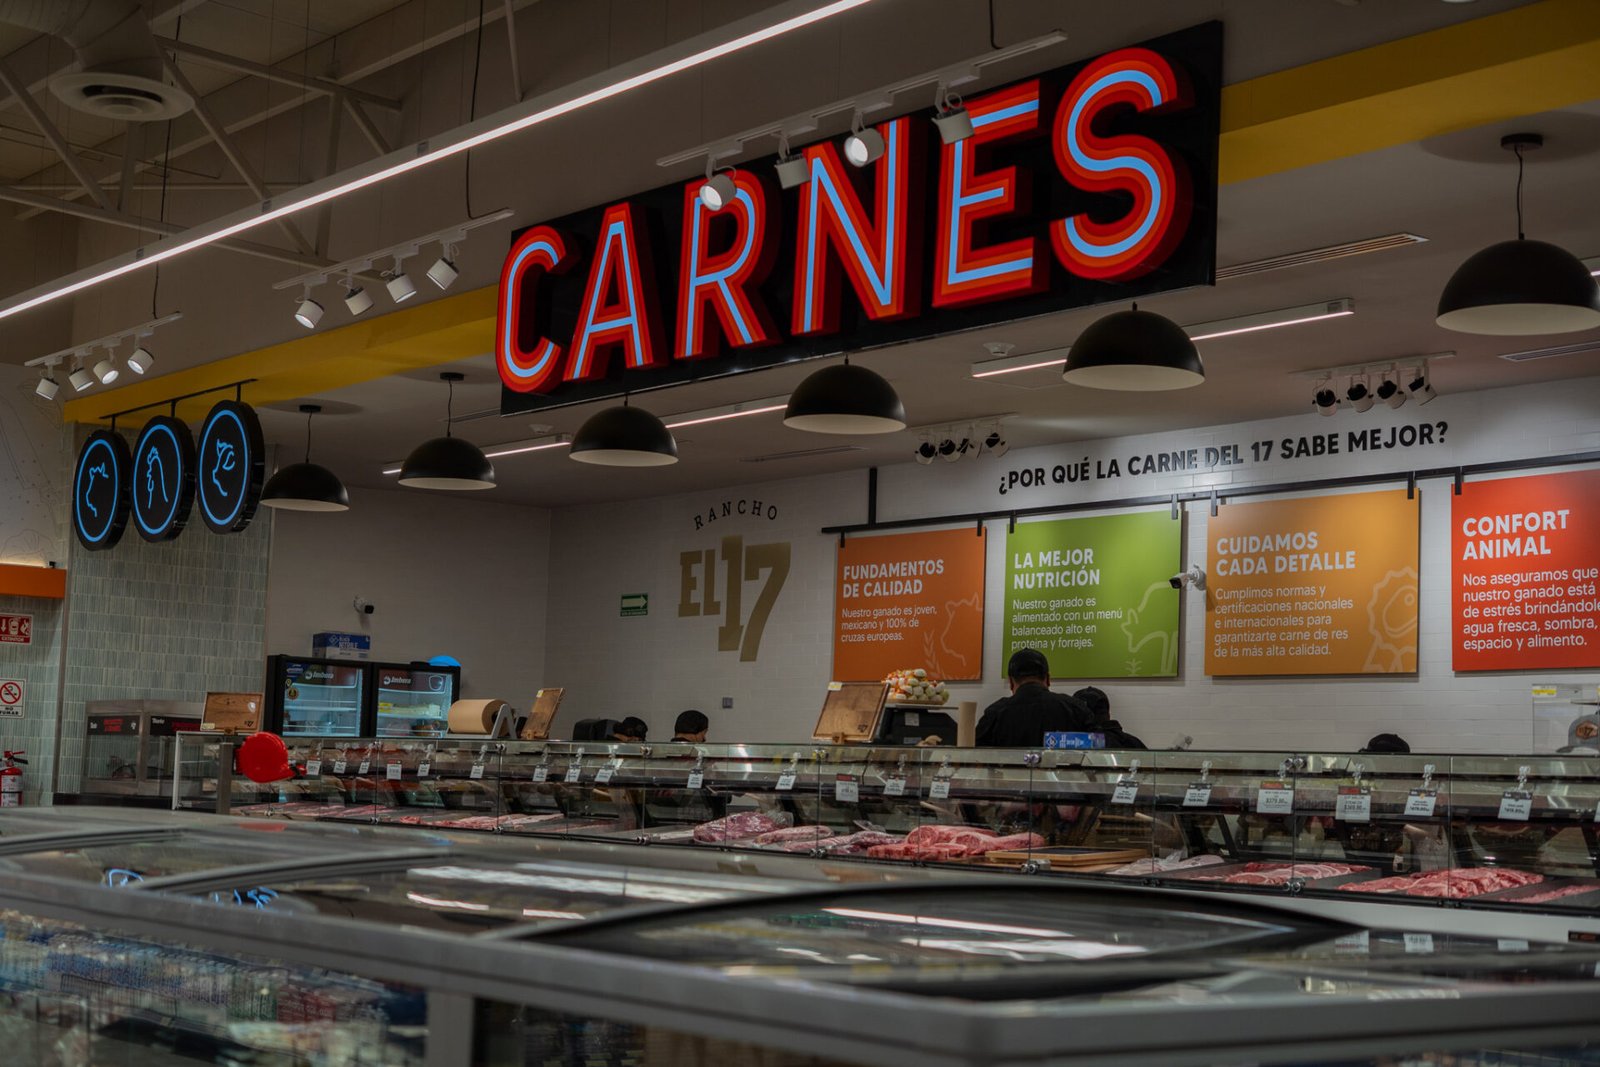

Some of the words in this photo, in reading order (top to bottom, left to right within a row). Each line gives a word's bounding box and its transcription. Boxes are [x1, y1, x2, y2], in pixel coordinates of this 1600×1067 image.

[495, 47, 1182, 393] CARNES
[999, 468, 1045, 495] ¿POR
[1052, 456, 1090, 483] QUÉ
[1096, 458, 1120, 479] LA
[1128, 449, 1197, 475] CARNE
[1205, 444, 1244, 465] DEL
[1251, 440, 1273, 461] 17
[1281, 433, 1339, 459] SABE
[1348, 421, 1448, 452] MEJOR?
[694, 500, 777, 530] RANCHO
[1463, 509, 1569, 537] CONFORT
[1217, 532, 1318, 556] CUIDAMOS
[1463, 536, 1551, 560] ANIMAL
[1015, 553, 1033, 569] LA
[1039, 549, 1093, 567] MEJOR
[1216, 557, 1267, 576] CADA
[1276, 551, 1355, 572] DETALLE
[844, 558, 944, 580] FUNDAMENTOS
[1014, 566, 1100, 589] NUTRICIÓN
[1464, 574, 1486, 586] Nos
[1490, 570, 1568, 587] aseguramos
[1572, 568, 1599, 583] que
[843, 583, 859, 598] DE
[864, 579, 922, 596] CALIDAD
[1216, 587, 1273, 601] Cumplimos
[1277, 586, 1316, 596] normas
[1319, 586, 1326, 597] y
[1464, 590, 1510, 602] nuestro
[1514, 584, 1563, 602] ganado
[1568, 582, 1595, 596] está
[678, 549, 720, 617] EL
[718, 535, 791, 662] 17
[1013, 599, 1047, 609] Nuestro
[1049, 597, 1083, 610] ganado
[1086, 598, 1096, 606] es
[1215, 599, 1291, 613] certificaciones
[1295, 599, 1353, 610] nacionales
[842, 608, 872, 617] Nuestro
[873, 606, 902, 619] ganado
[914, 606, 937, 617] joven,
[1012, 611, 1061, 623] alimentado
[1063, 612, 1080, 621] con
[1083, 611, 1094, 620] un
[1097, 608, 1122, 619] menú
[1463, 606, 1479, 618] de
[1483, 603, 1521, 617] estrés
[842, 621, 877, 630] mexicano
[879, 621, 884, 631] y
[887, 618, 907, 628] 100%
[909, 618, 919, 627] de
[1012, 624, 1063, 636] balanceado
[1066, 624, 1083, 634] alto
[1085, 625, 1096, 633] en
[1215, 620, 1221, 628] e
[1224, 615, 1304, 628] internacionales
[1307, 616, 1332, 627] para
[1464, 623, 1494, 636] agua
[1498, 620, 1540, 632] fresca,
[1545, 616, 1597, 630] sombra,
[841, 634, 865, 642] cruzas
[867, 633, 904, 643] europeas.
[1051, 640, 1056, 650] y
[1058, 637, 1093, 649] forrajes.
[1214, 630, 1276, 644] garantizarte
[1280, 631, 1311, 640] carne
[1314, 629, 1328, 640] de
[1332, 630, 1348, 639] res
[1464, 639, 1512, 652] espacio
[1516, 638, 1523, 650] y
[1528, 634, 1587, 647] alimento.
[1214, 645, 1227, 657] de
[1230, 646, 1239, 656] la
[1242, 646, 1263, 656] más
[1266, 645, 1285, 656] alta
[1289, 643, 1331, 655] calidad.
